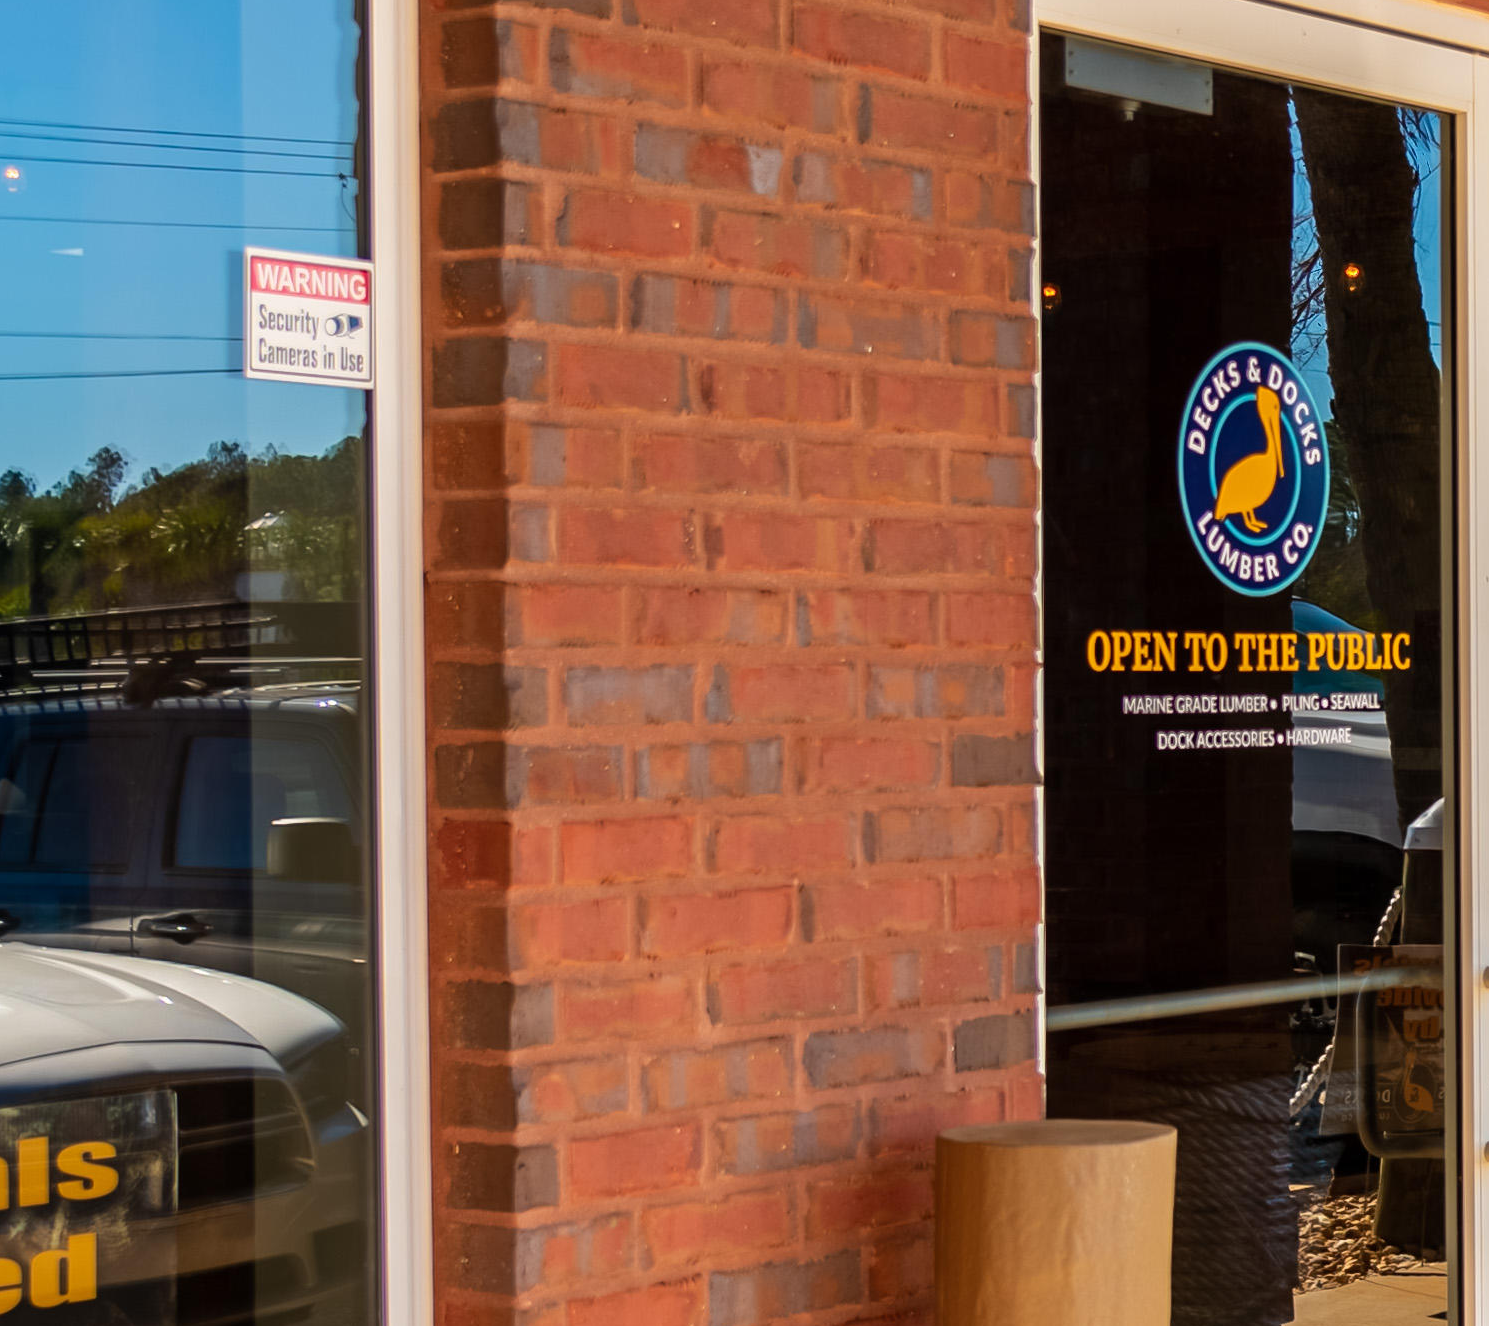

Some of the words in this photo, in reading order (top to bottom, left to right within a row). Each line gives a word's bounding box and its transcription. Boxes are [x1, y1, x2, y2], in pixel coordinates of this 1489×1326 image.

[257, 262, 367, 301] WARNING
[258, 304, 319, 341] Security
[258, 338, 318, 369] Cameras
[323, 344, 335, 370] in
[340, 346, 364, 372] Use
[1187, 361, 1241, 455] DECKS
[1246, 356, 1261, 383] &
[1267, 363, 1321, 466] DOCKS
[1196, 510, 1280, 582] LUMBER
[1282, 523, 1313, 565] CO.
[1086, 630, 1178, 672] OPEN
[1184, 632, 1228, 672] TO
[1235, 632, 1299, 672] THE
[1307, 632, 1411, 671] PUBLIC
[1123, 696, 1173, 714] MARINE
[1176, 695, 1217, 713] GRADE
[1219, 695, 1268, 713] LUMBER
[1282, 694, 1319, 711] PILING
[1330, 693, 1381, 710] SEAWALL
[1157, 731, 1194, 750] DOCK
[1196, 730, 1275, 749] ACCESSORIES
[1286, 727, 1352, 746] HARDWARE
